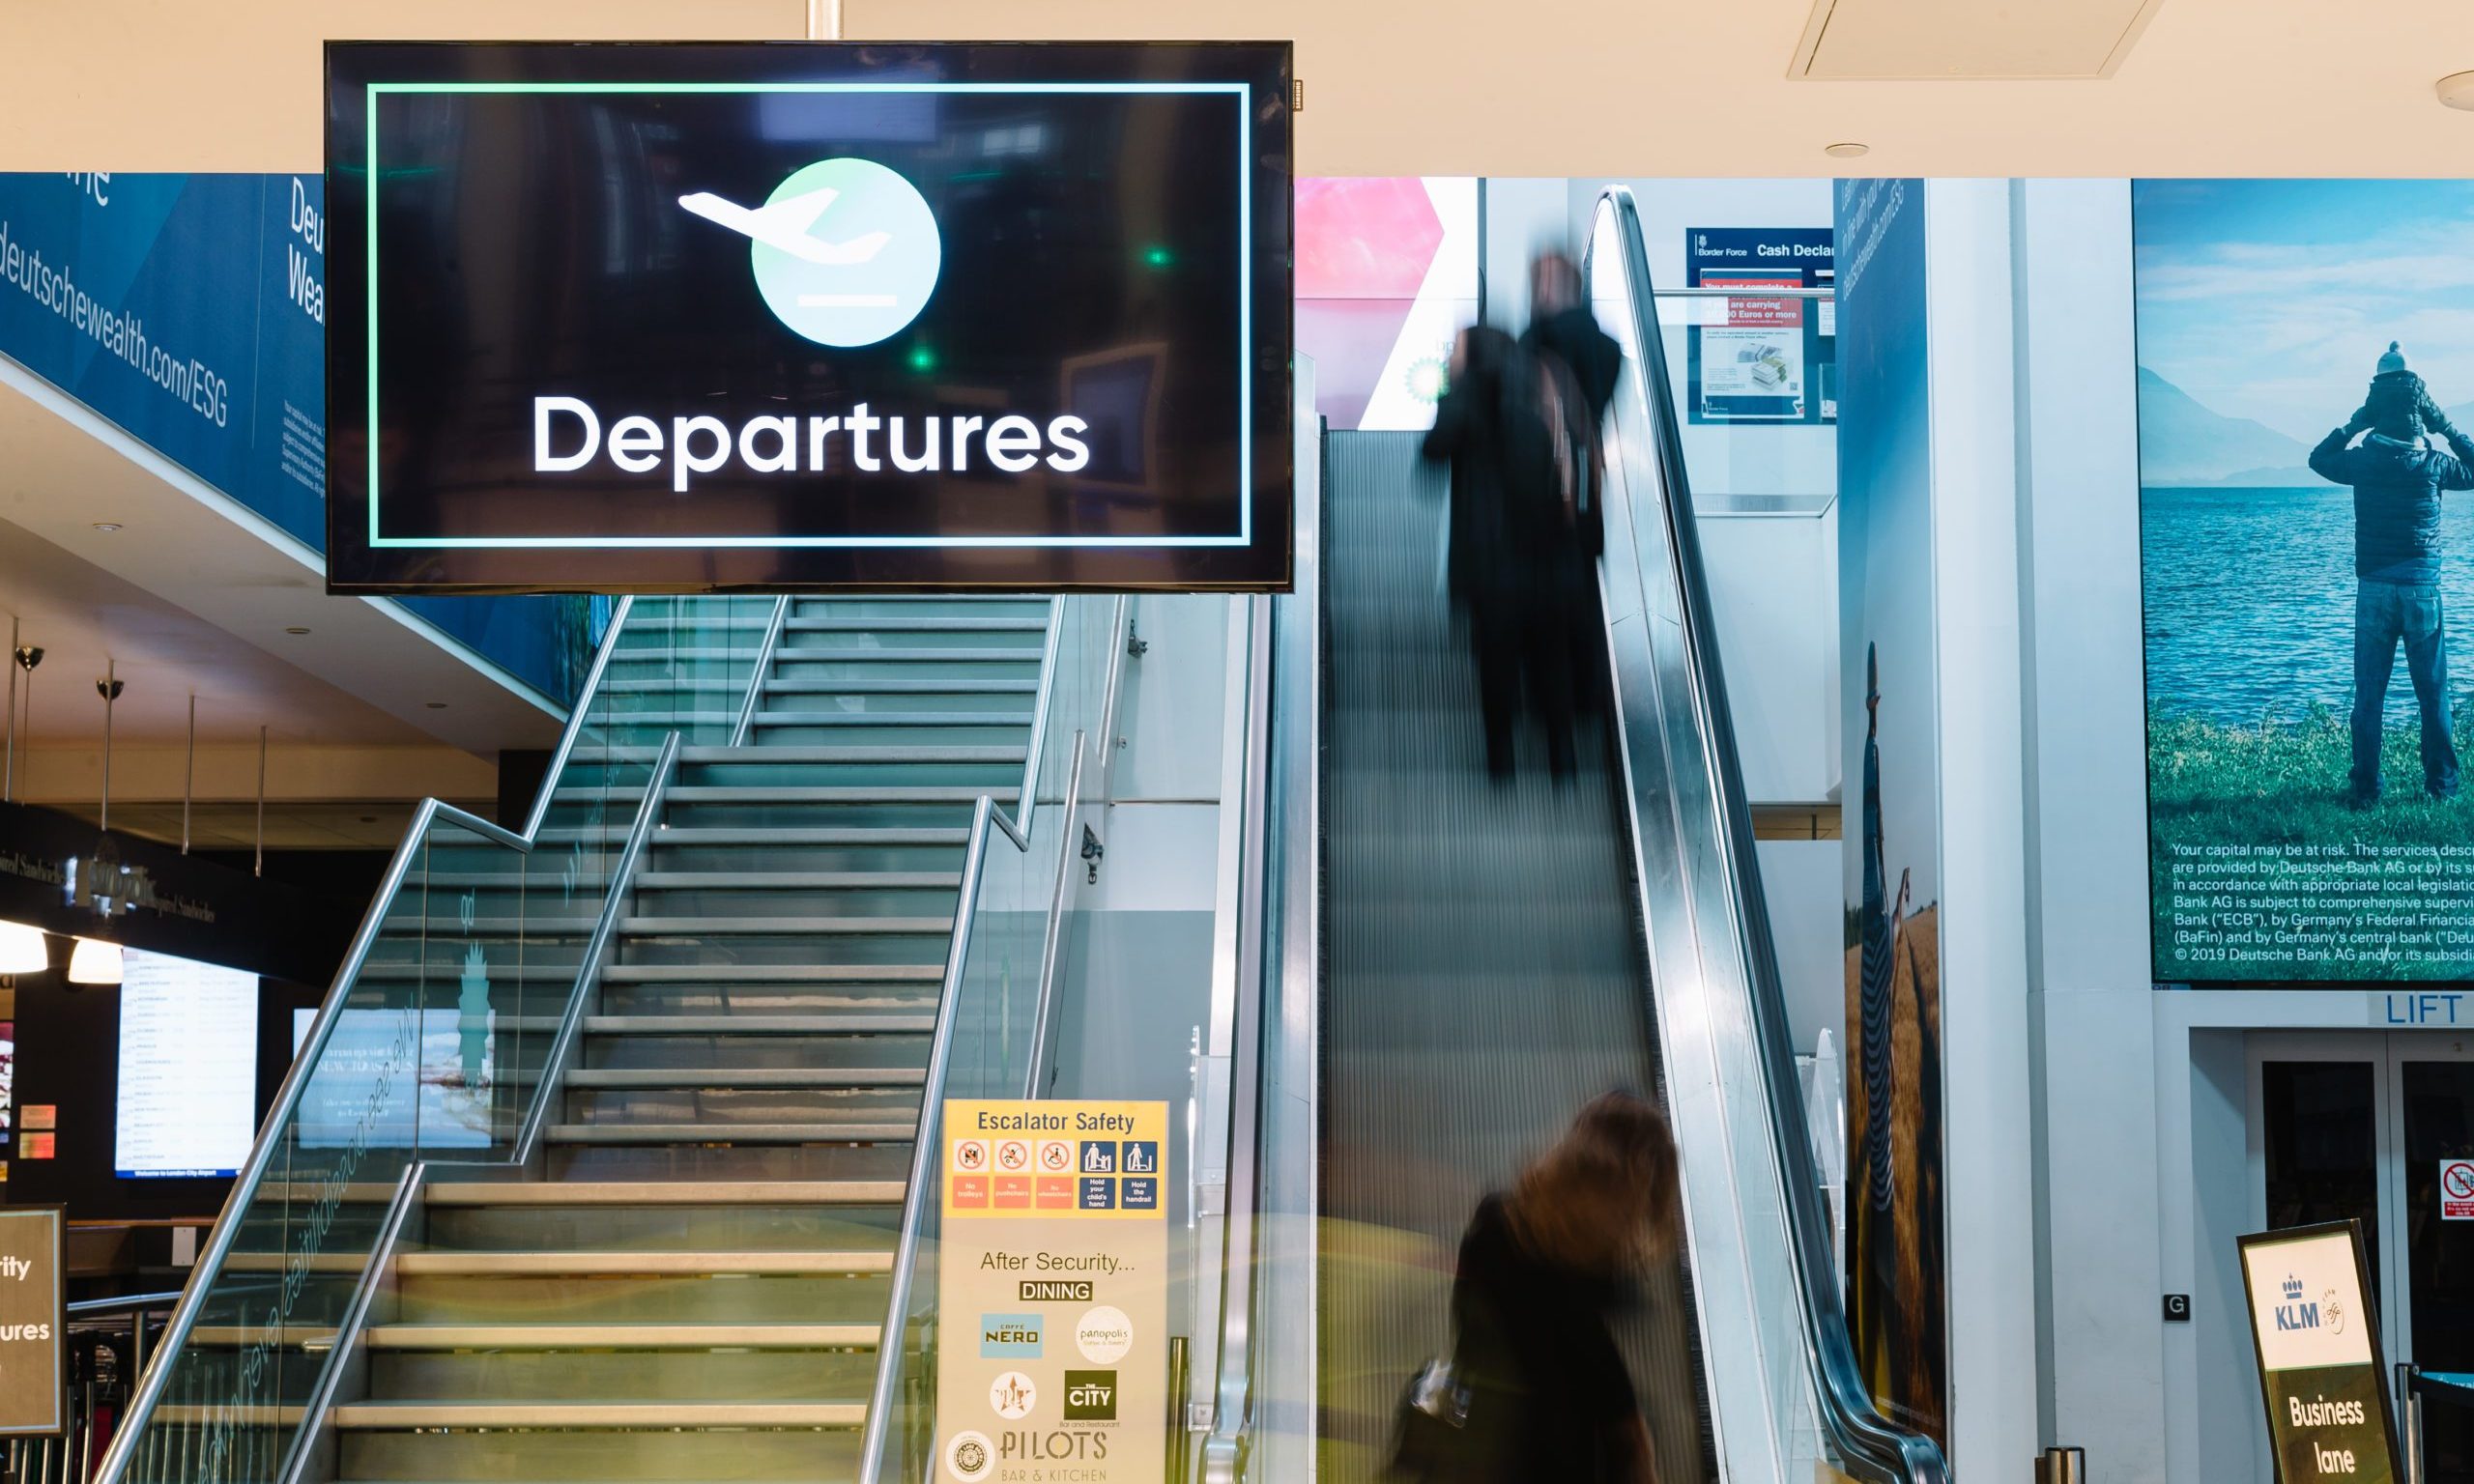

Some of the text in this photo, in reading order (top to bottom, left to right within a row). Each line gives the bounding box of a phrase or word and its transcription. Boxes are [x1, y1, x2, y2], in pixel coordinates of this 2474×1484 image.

[291, 176, 325, 255] Deu
[1698, 248, 1747, 257] Border Force
[1757, 243, 1790, 257] Cash
[289, 243, 325, 328] Wea
[1746, 300, 1781, 310] carrying
[1739, 310, 1763, 319] Euros
[534, 395, 1090, 493] Departures
[2172, 843, 2474, 858] Your capital may be at risk. The services desc
[2172, 863, 2194, 873] are
[2198, 861, 2257, 875] provided
[2259, 861, 2277, 875] by
[2280, 861, 2344, 873] Deutsche
[2346, 861, 2380, 873] Bank
[2384, 861, 2405, 873] AG
[2408, 863, 2422, 873] or
[2426, 861, 2442, 875] by
[2446, 861, 2462, 873] its
[2173, 878, 2185, 891] in
[2189, 878, 2266, 891] accordance
[2270, 878, 2298, 891] with
[2301, 878, 2379, 893] appropriate
[2383, 878, 2413, 891] local
[2174, 896, 2207, 908] Bank
[2211, 896, 2232, 908] AG
[2236, 896, 2247, 908] is
[2250, 897, 2298, 911] subject
[2302, 898, 2316, 908] to
[2319, 897, 2421, 910] comprehensive
[2174, 913, 2208, 926] Bank
[2271, 913, 2287, 928] by
[2367, 913, 2415, 926] Federal
[2174, 930, 2223, 946] (BaFin)
[2226, 930, 2252, 943] and
[2255, 930, 2271, 946] by
[2349, 930, 2396, 943] central
[2400, 930, 2431, 943] bank
[2191, 948, 2226, 960] 2019
[2229, 948, 2293, 960] Deutsche
[2297, 948, 2331, 960] Bank
[2334, 948, 2355, 960] AG
[2358, 948, 2402, 962] and/or
[2405, 948, 2422, 960] its
[2425, 948, 2474, 961] subsidi
[2386, 994, 2463, 1023] LIFT
[978, 1111, 1135, 1135] Escalator Safety
[981, 1252, 1136, 1275] After Security...
[1022, 1283, 1090, 1299] DINING
[2169, 1296, 2185, 1314] G
[2275, 1302, 2320, 1331] KLM
[986, 1331, 1038, 1343] NERO
[1080, 1328, 1129, 1341] panopolis
[1069, 1389, 1111, 1407] CITY
[2288, 1395, 2365, 1428] Business
[999, 1431, 1108, 1460] PILOTS
[2314, 1442, 2357, 1474] lane
[1001, 1469, 1107, 1482] BAR & KITCHEN
